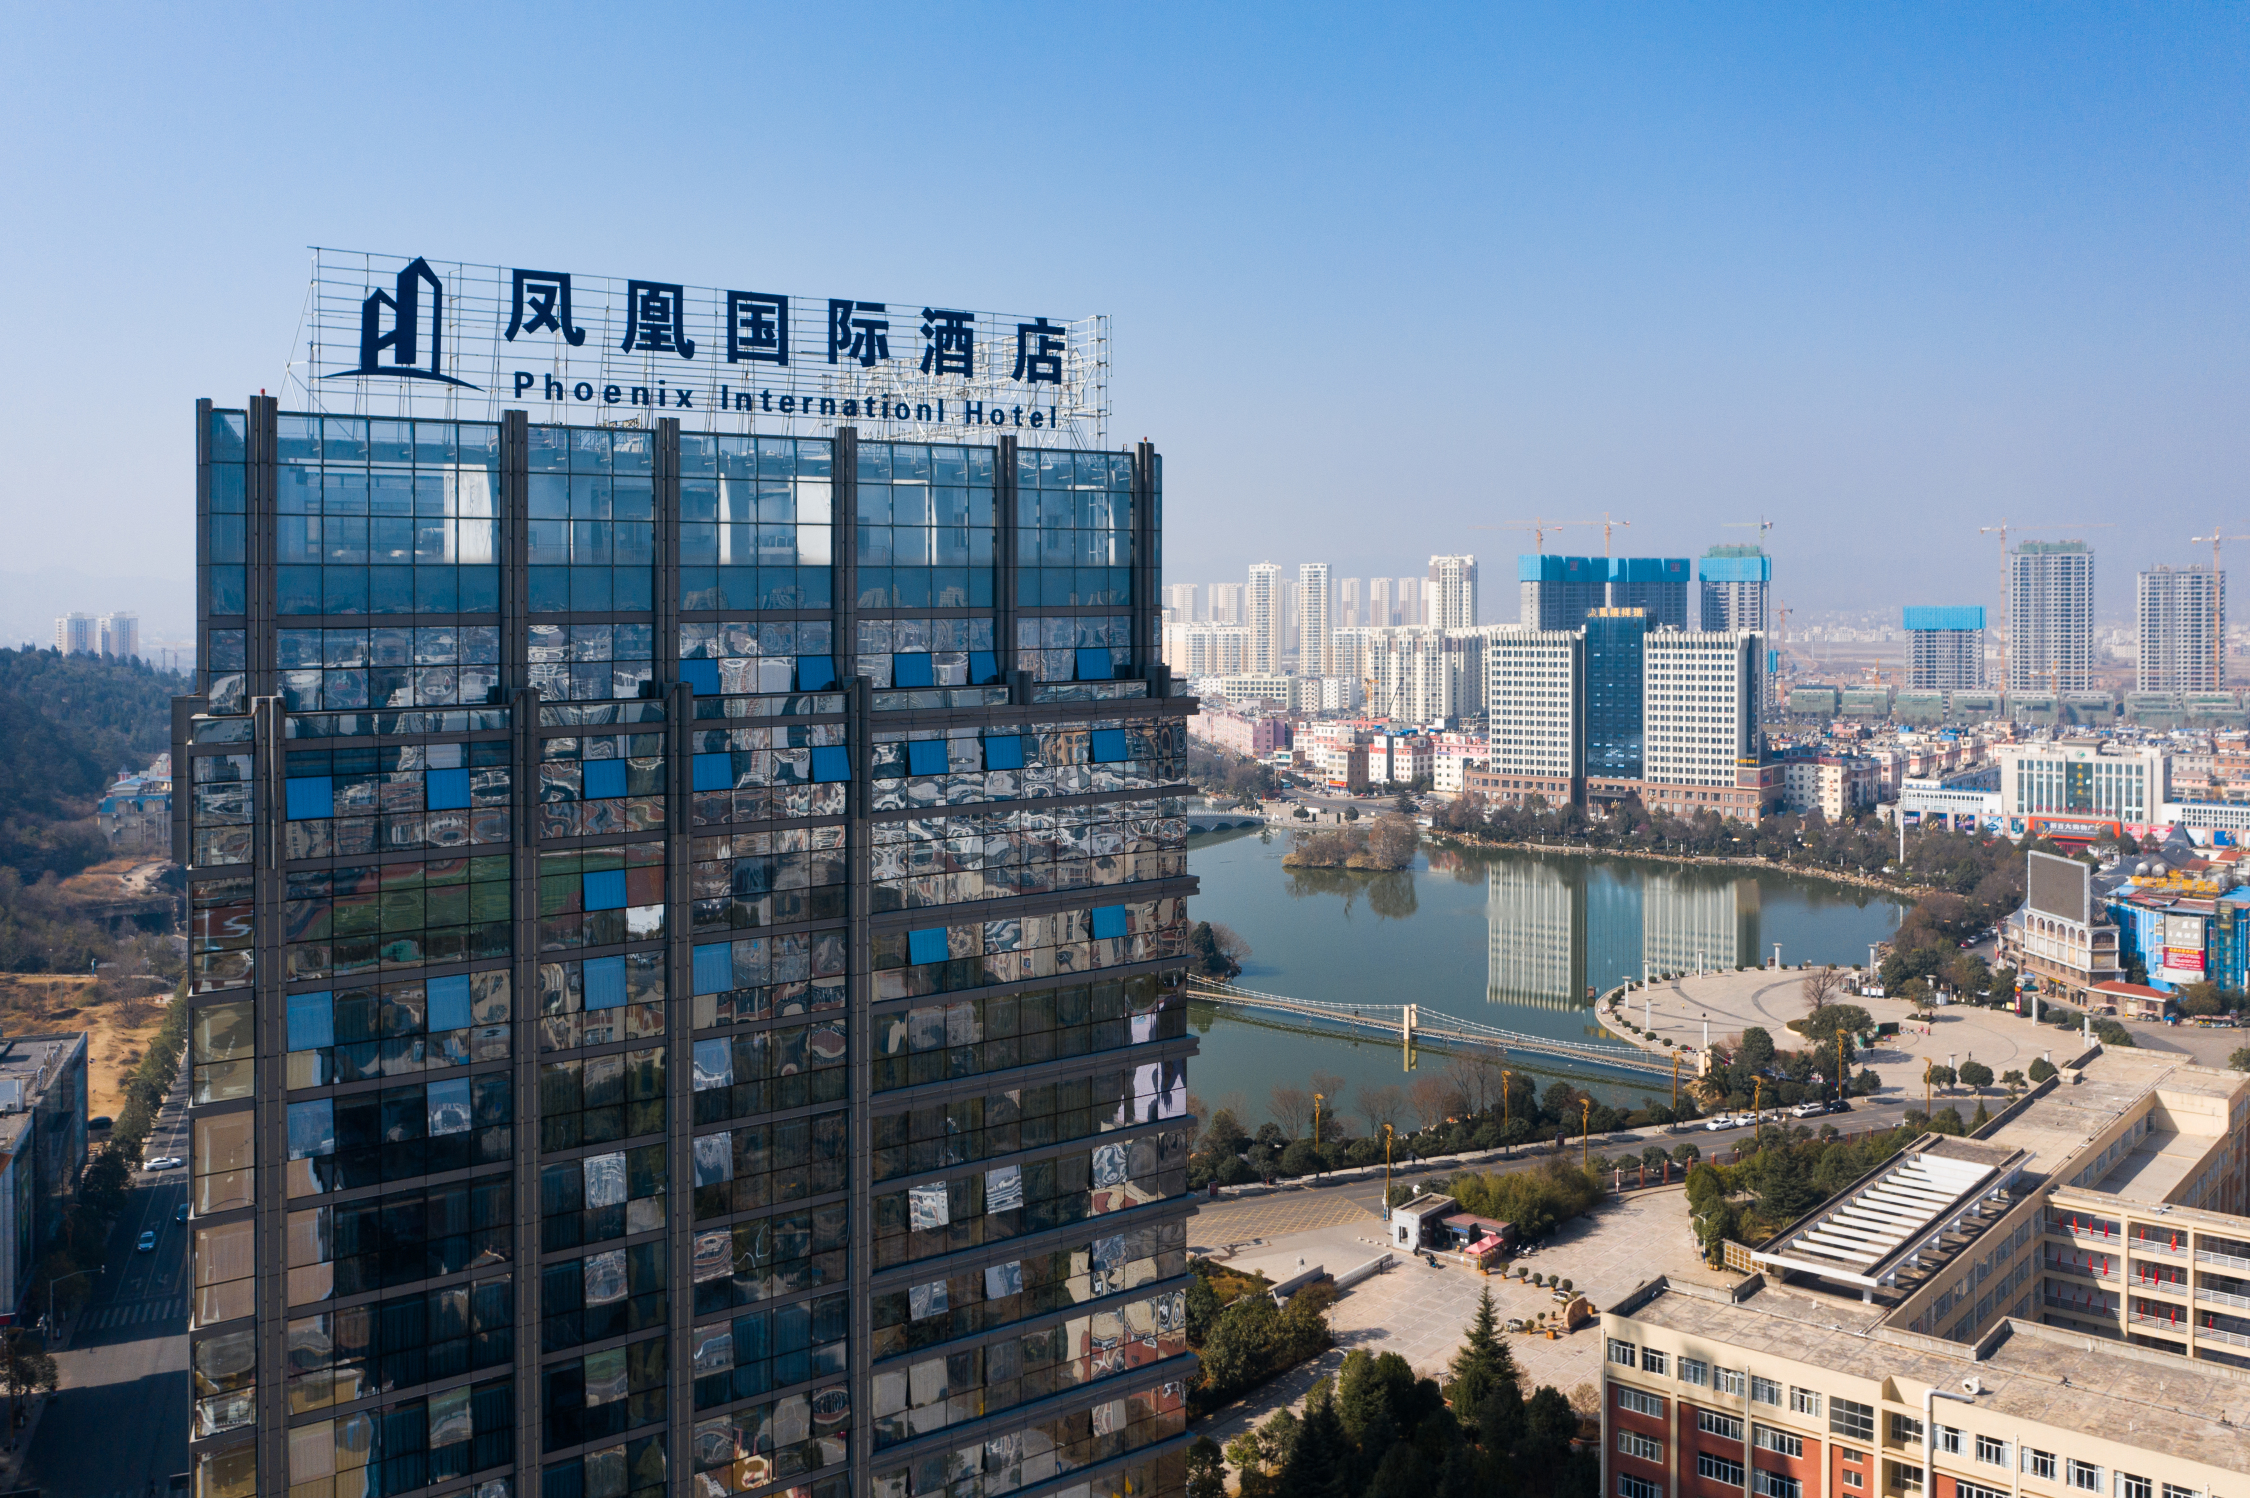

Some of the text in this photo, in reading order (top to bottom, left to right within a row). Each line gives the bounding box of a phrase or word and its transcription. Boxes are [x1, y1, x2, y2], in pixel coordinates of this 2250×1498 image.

[504, 268, 1065, 385] 凤凰国际酒店
[514, 371, 1056, 428] Phoenix Internationl Hotel
[2050, 822, 2099, 832] 新百大购物广
